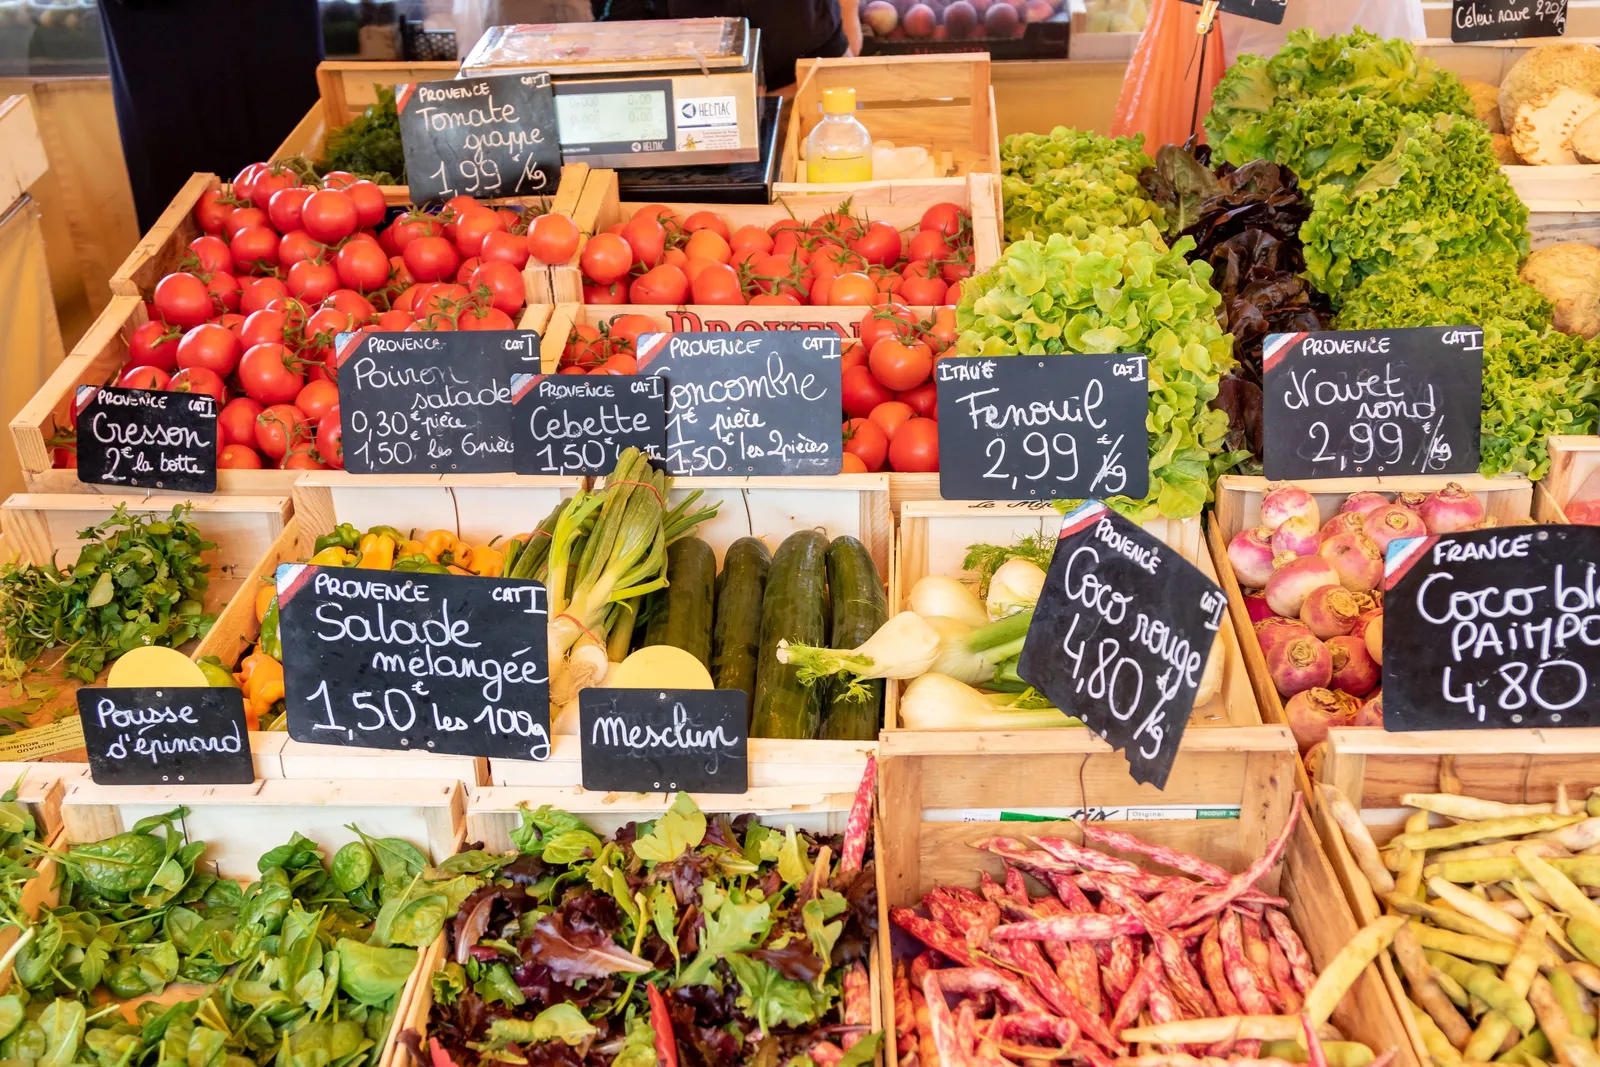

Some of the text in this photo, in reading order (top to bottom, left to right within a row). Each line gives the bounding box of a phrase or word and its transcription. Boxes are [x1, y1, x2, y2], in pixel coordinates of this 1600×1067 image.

[1498, 7, 1531, 23] rave
[418, 82, 490, 102] PROVENCE
[698, 102, 732, 117] HELMAC
[416, 95, 520, 131] Tomate
[463, 128, 545, 165] grappe
[642, 140, 664, 151] HELMAC
[429, 159, 502, 197] 1,99
[670, 337, 763, 359] PROVENCE
[1302, 337, 1391, 356] PROVENCE
[353, 357, 469, 391] Poivron
[539, 381, 616, 399] PROVENCE
[1284, 362, 1405, 410] Navet
[98, 389, 168, 409] PROVENCE
[410, 378, 512, 411] salade
[955, 378, 1107, 429] Fenouil
[1356, 383, 1436, 420] rond
[93, 412, 211, 449] Cresson
[530, 404, 650, 442] Cebette
[131, 451, 154, 473] la
[160, 452, 205, 474] botte
[427, 438, 453, 459] les
[740, 432, 766, 460] les
[982, 431, 1079, 490] 2,99
[1309, 421, 1404, 471] 2,99
[1095, 517, 1162, 575] PROVENCE
[1434, 533, 1533, 565] FRANCE
[314, 573, 430, 603] PROVENCE
[1417, 563, 1600, 624] Coco bl
[315, 598, 482, 648] Salade
[1065, 546, 1202, 700] Coco rouge
[1063, 613, 1143, 721] 4,80
[1443, 660, 1588, 722] 4,80
[98, 697, 199, 728] Pousse
[432, 703, 468, 732] les
[592, 702, 739, 749] Mesclun
[17, 742, 55, 754] RICHAUD
[106, 720, 242, 764] d'épinard
